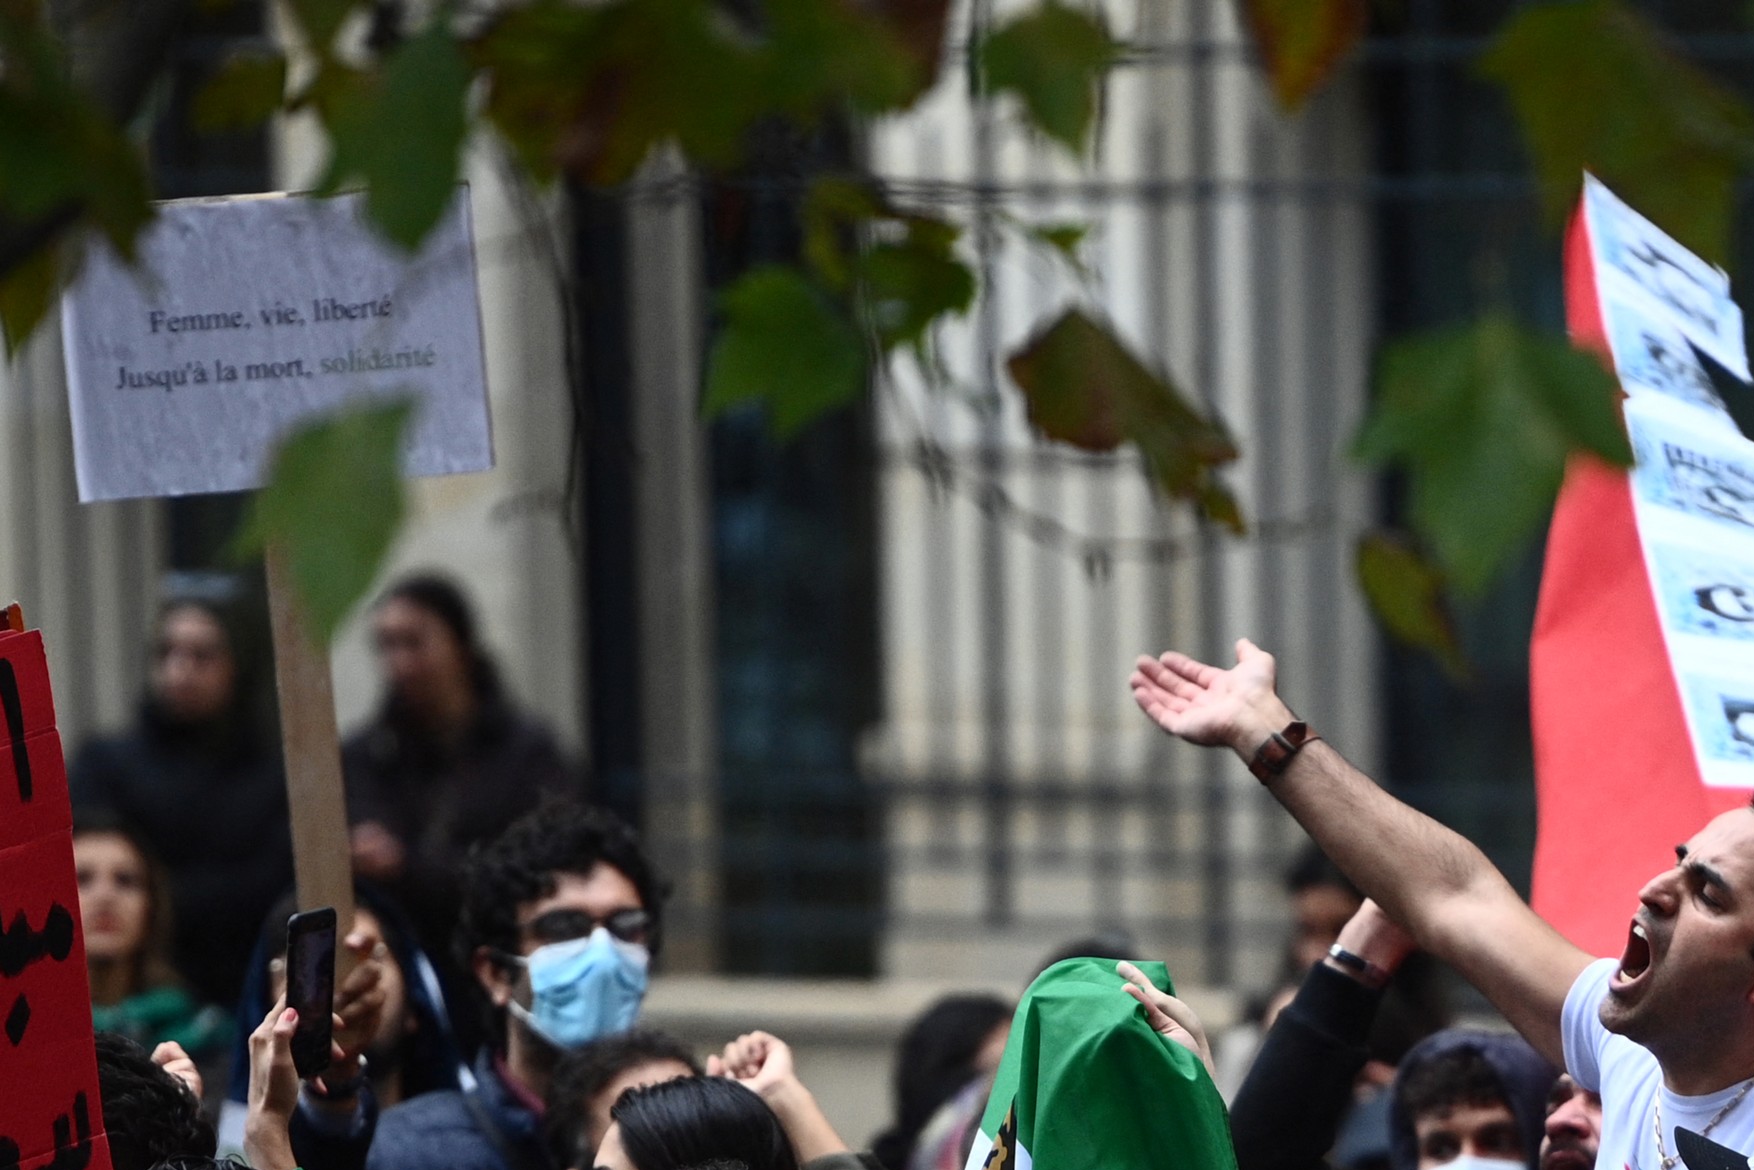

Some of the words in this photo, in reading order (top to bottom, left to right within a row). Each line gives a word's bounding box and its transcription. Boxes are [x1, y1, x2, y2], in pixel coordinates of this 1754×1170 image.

[149, 310, 251, 333] Femme,
[260, 302, 306, 327] vie,
[312, 294, 391, 323] liberté
[116, 361, 207, 392] Jusqu'à
[215, 359, 238, 384] la
[245, 358, 313, 382] mort,
[320, 344, 436, 374] solidarité
